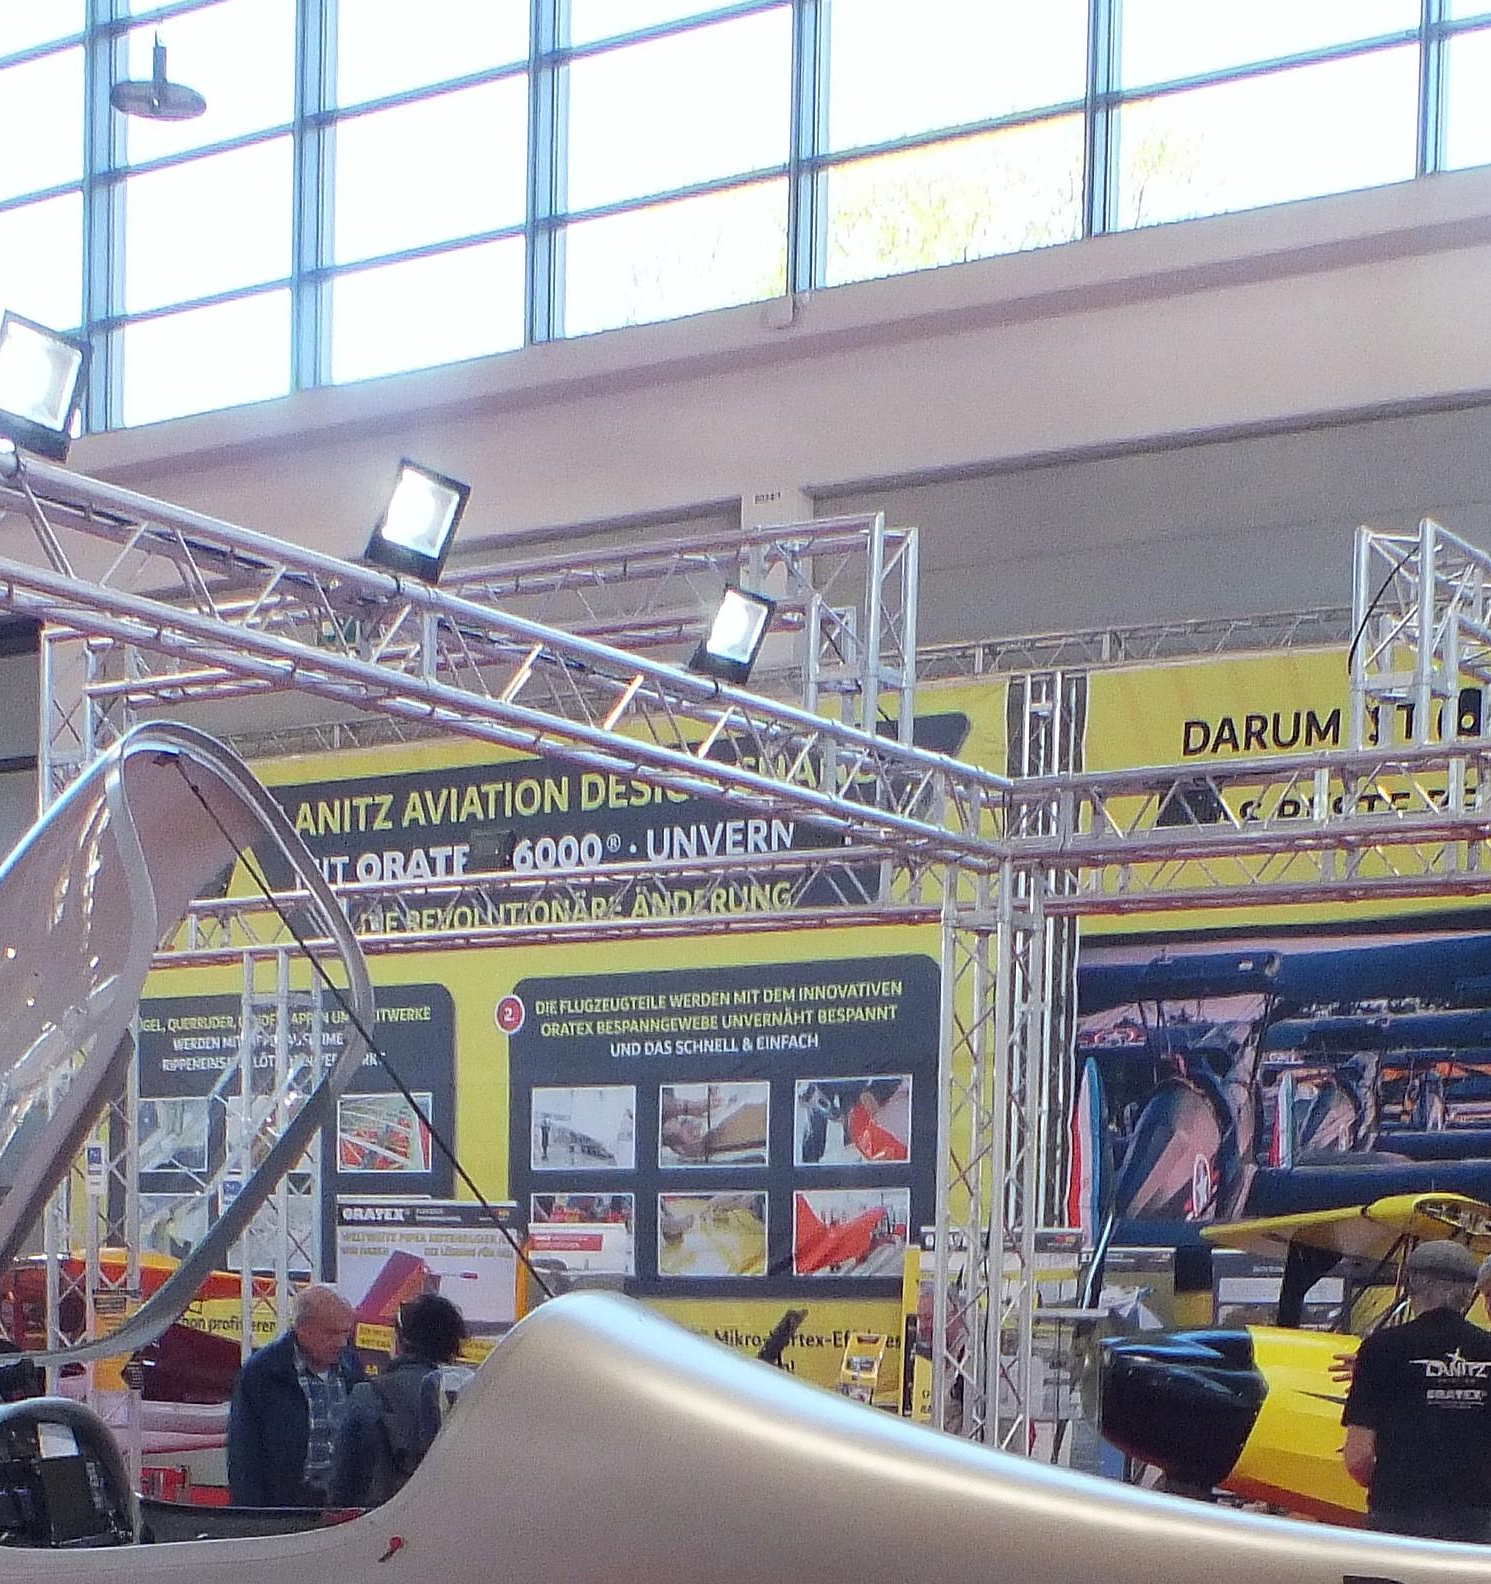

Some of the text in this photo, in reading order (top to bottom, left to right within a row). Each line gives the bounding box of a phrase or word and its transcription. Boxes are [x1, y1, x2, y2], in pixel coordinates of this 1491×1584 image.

[1182, 708, 1341, 757] DARUM
[295, 790, 394, 835] ANITZ
[402, 774, 569, 827] AVIATION
[580, 767, 694, 812] DESIG
[356, 842, 471, 884] ORATE
[645, 817, 796, 862] UNVERN
[374, 1005, 432, 1023] ITWERKE
[504, 1006, 515, 1023] 2
[536, 980, 903, 1016] DIE FLUGZEUGTEILE WERDEN MIT DEM INNOVATIVEN
[541, 1003, 898, 1038] ORATEX BESPANNGEWEBE UNVERNÄHT BESPANNT
[610, 1032, 819, 1058] UND DAS SCHNELL & EINFACH
